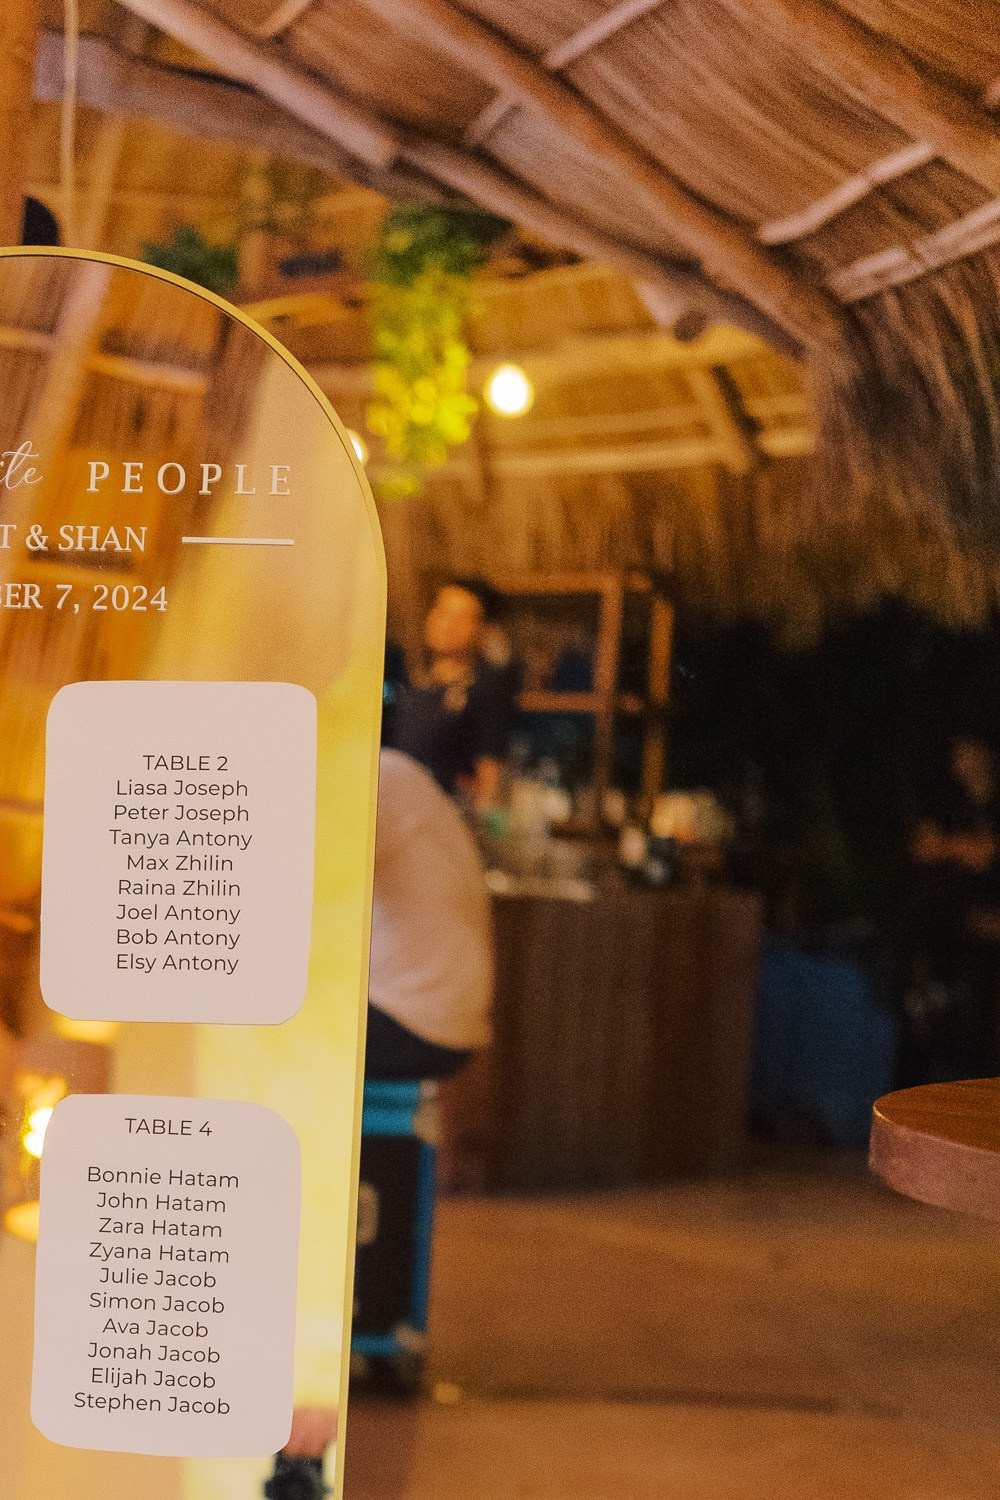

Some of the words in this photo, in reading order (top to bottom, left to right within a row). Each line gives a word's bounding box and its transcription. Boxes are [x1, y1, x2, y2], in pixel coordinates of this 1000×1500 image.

[87, 461, 291, 495] PEOPLE
[25, 524, 49, 551] &
[58, 524, 148, 552] SHAN
[56, 584, 80, 614] 7,
[92, 584, 167, 611] 2024
[141, 754, 211, 772] TABLE
[216, 755, 229, 772] 2
[116, 778, 168, 797] Liasa
[172, 779, 249, 801] Joseph
[113, 803, 170, 821] Peter
[173, 803, 250, 826] Joseph
[108, 828, 170, 850] Tanya
[175, 829, 254, 852] Antony
[126, 853, 170, 872] Max
[174, 853, 234, 872] Zhilin
[117, 877, 176, 897] Raina
[181, 878, 241, 897] Zhilin
[115, 903, 159, 921] Joel
[163, 904, 242, 926] Antony
[116, 927, 159, 946] Bob
[163, 929, 242, 951] Antony
[116, 952, 158, 975] Elsy
[161, 953, 240, 976] Antony
[123, 1117, 193, 1137] TABLE
[198, 1120, 214, 1137] 4
[87, 1165, 162, 1186] Bonnie
[168, 1168, 240, 1189] Hatam
[95, 1191, 149, 1210] John
[155, 1193, 227, 1214] Hatam
[98, 1216, 145, 1236] Zara
[151, 1218, 223, 1239] Hatam
[88, 1241, 152, 1263] Zyana
[158, 1244, 230, 1264] Hatam
[98, 1266, 149, 1286] Julie
[153, 1269, 217, 1289] Jacob
[88, 1290, 157, 1311] Simon
[161, 1294, 226, 1315] Jacob
[101, 1317, 140, 1336] Ava
[145, 1319, 209, 1339] Jacob
[87, 1341, 152, 1361] Jonah
[157, 1344, 221, 1364] Jacob
[91, 1366, 148, 1389] Elijah
[152, 1369, 217, 1390] Jacob
[73, 1391, 162, 1414] Stephen
[166, 1395, 231, 1416] Jacob
